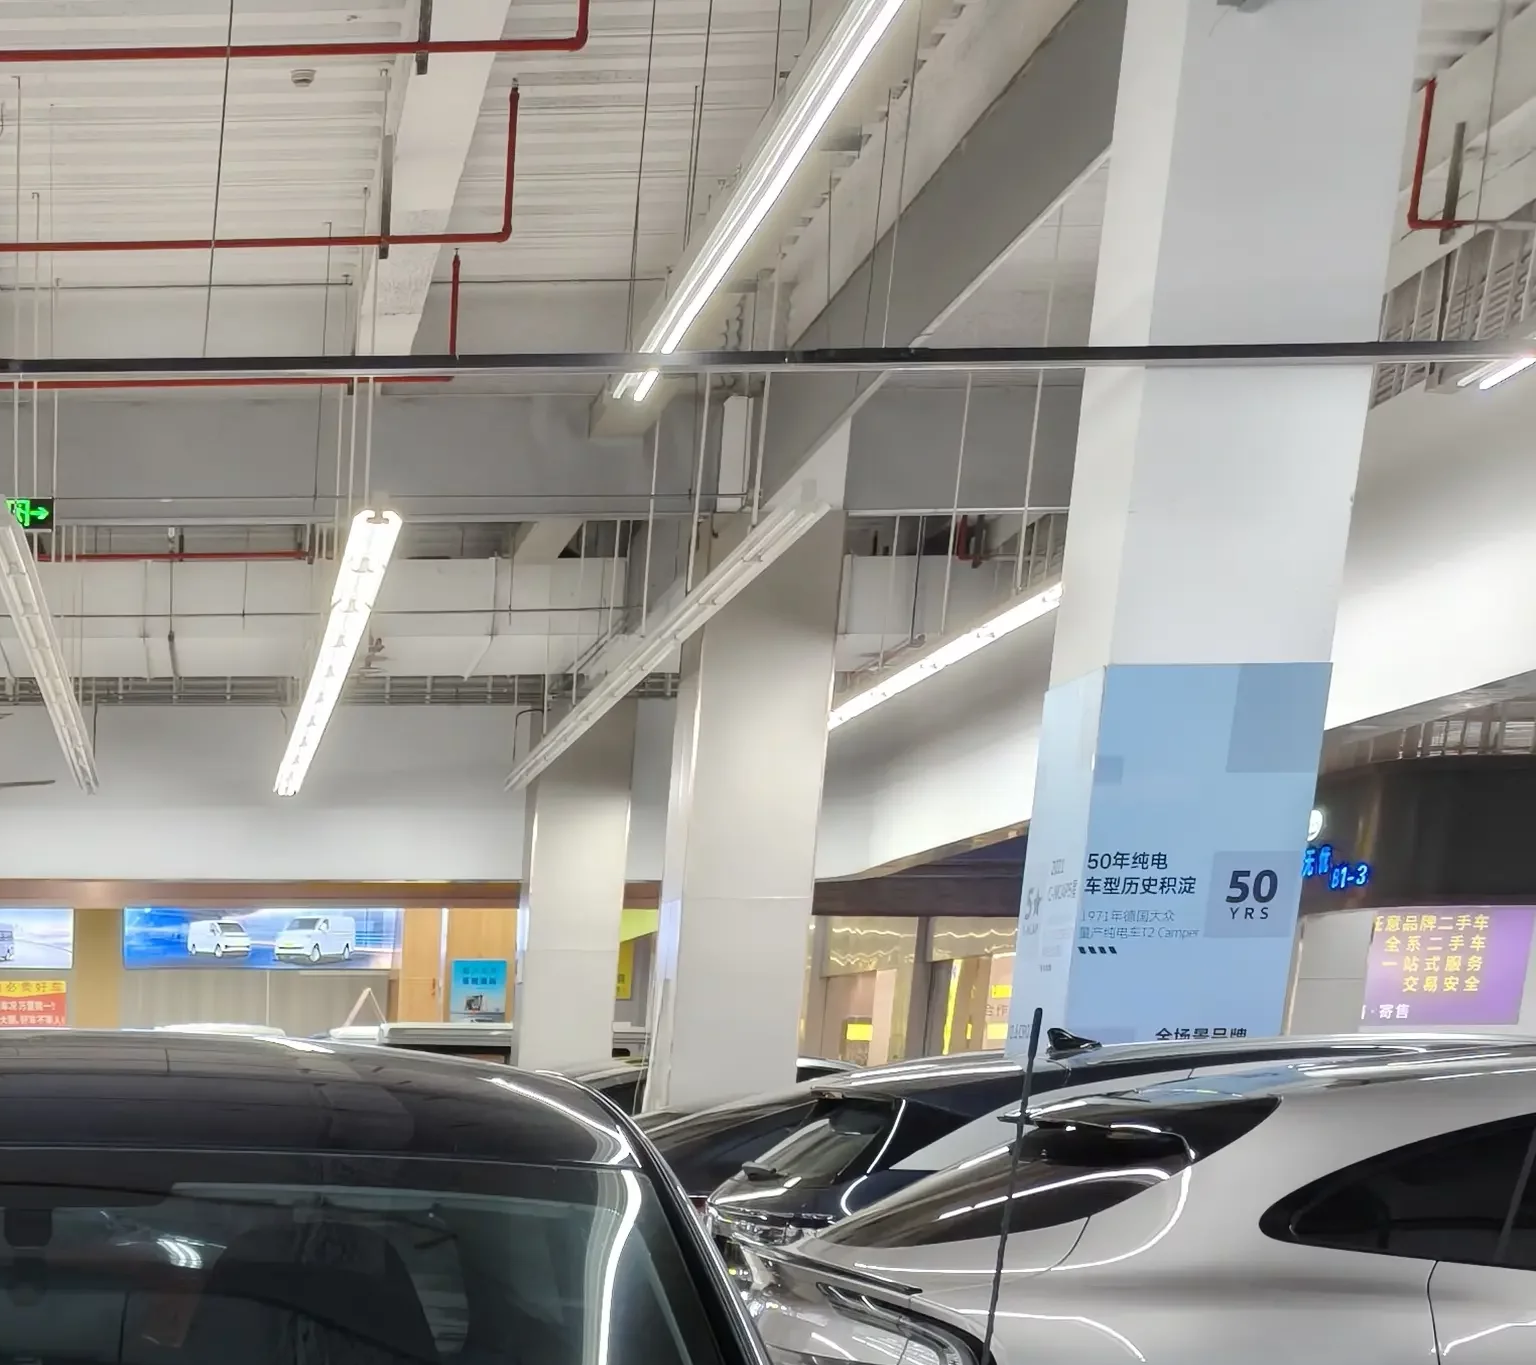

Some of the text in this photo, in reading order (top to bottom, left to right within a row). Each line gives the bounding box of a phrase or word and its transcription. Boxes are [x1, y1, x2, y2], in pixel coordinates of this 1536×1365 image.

[1087, 852, 1168, 870] 50年纯电
[1331, 864, 1368, 888] B1-3
[1084, 876, 1197, 895] 车型历史积淀
[1226, 869, 1279, 904] 50
[1082, 909, 1175, 923] 1971年德国大众
[1229, 907, 1269, 920] YRS
[1384, 935, 1487, 952] 全系二手车
[1381, 955, 1483, 972] 一站式服务
[1402, 976, 1481, 992] 交易安全
